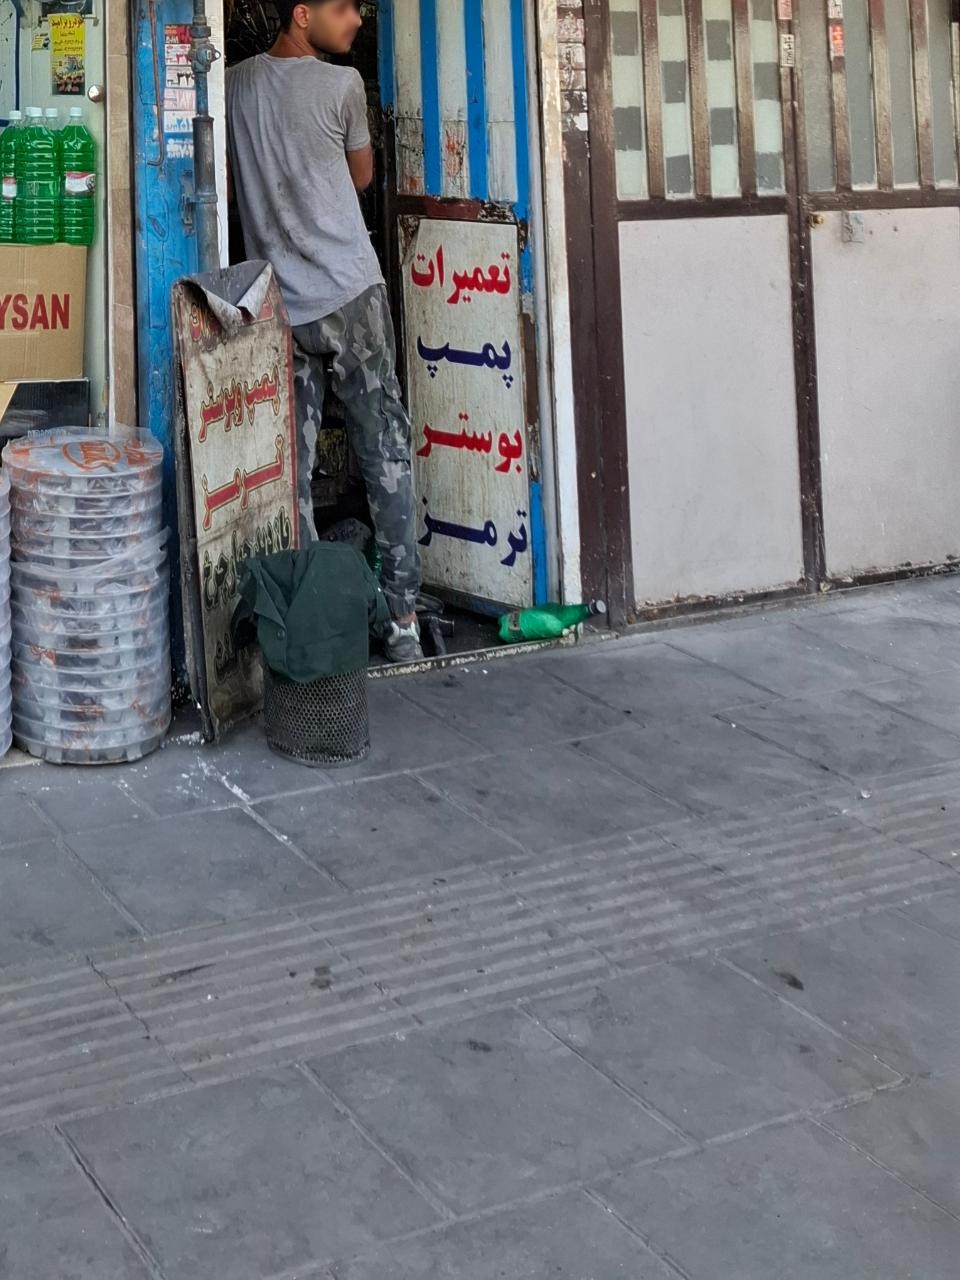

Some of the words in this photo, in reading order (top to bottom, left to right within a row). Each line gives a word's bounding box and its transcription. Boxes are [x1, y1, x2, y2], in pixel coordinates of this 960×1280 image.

[410, 244, 512, 305] تعمیرات
[416, 334, 515, 390] پمپ
[415, 412, 524, 474] بوستر
[202, 434, 285, 531] ترمز
[417, 495, 529, 568] ترمز
